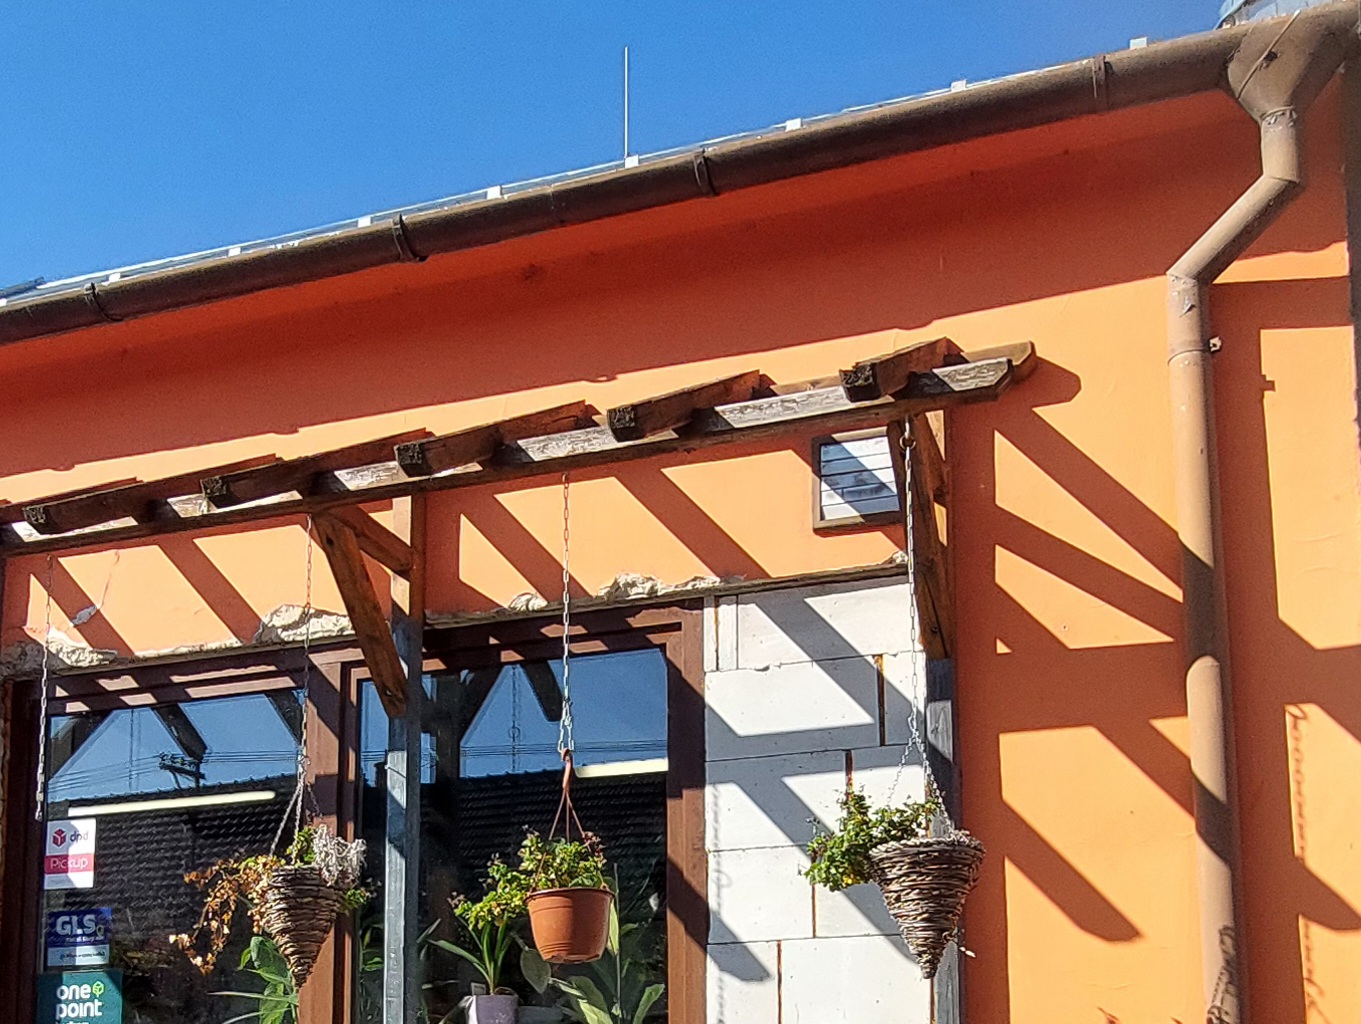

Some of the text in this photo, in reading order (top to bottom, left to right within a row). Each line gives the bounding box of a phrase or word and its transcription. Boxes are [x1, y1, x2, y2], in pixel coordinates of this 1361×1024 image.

[69, 830, 89, 843] dpd
[50, 857, 89, 869] Pickup
[56, 914, 96, 936] GLS
[56, 984, 92, 1000] one
[55, 999, 103, 1020] point
